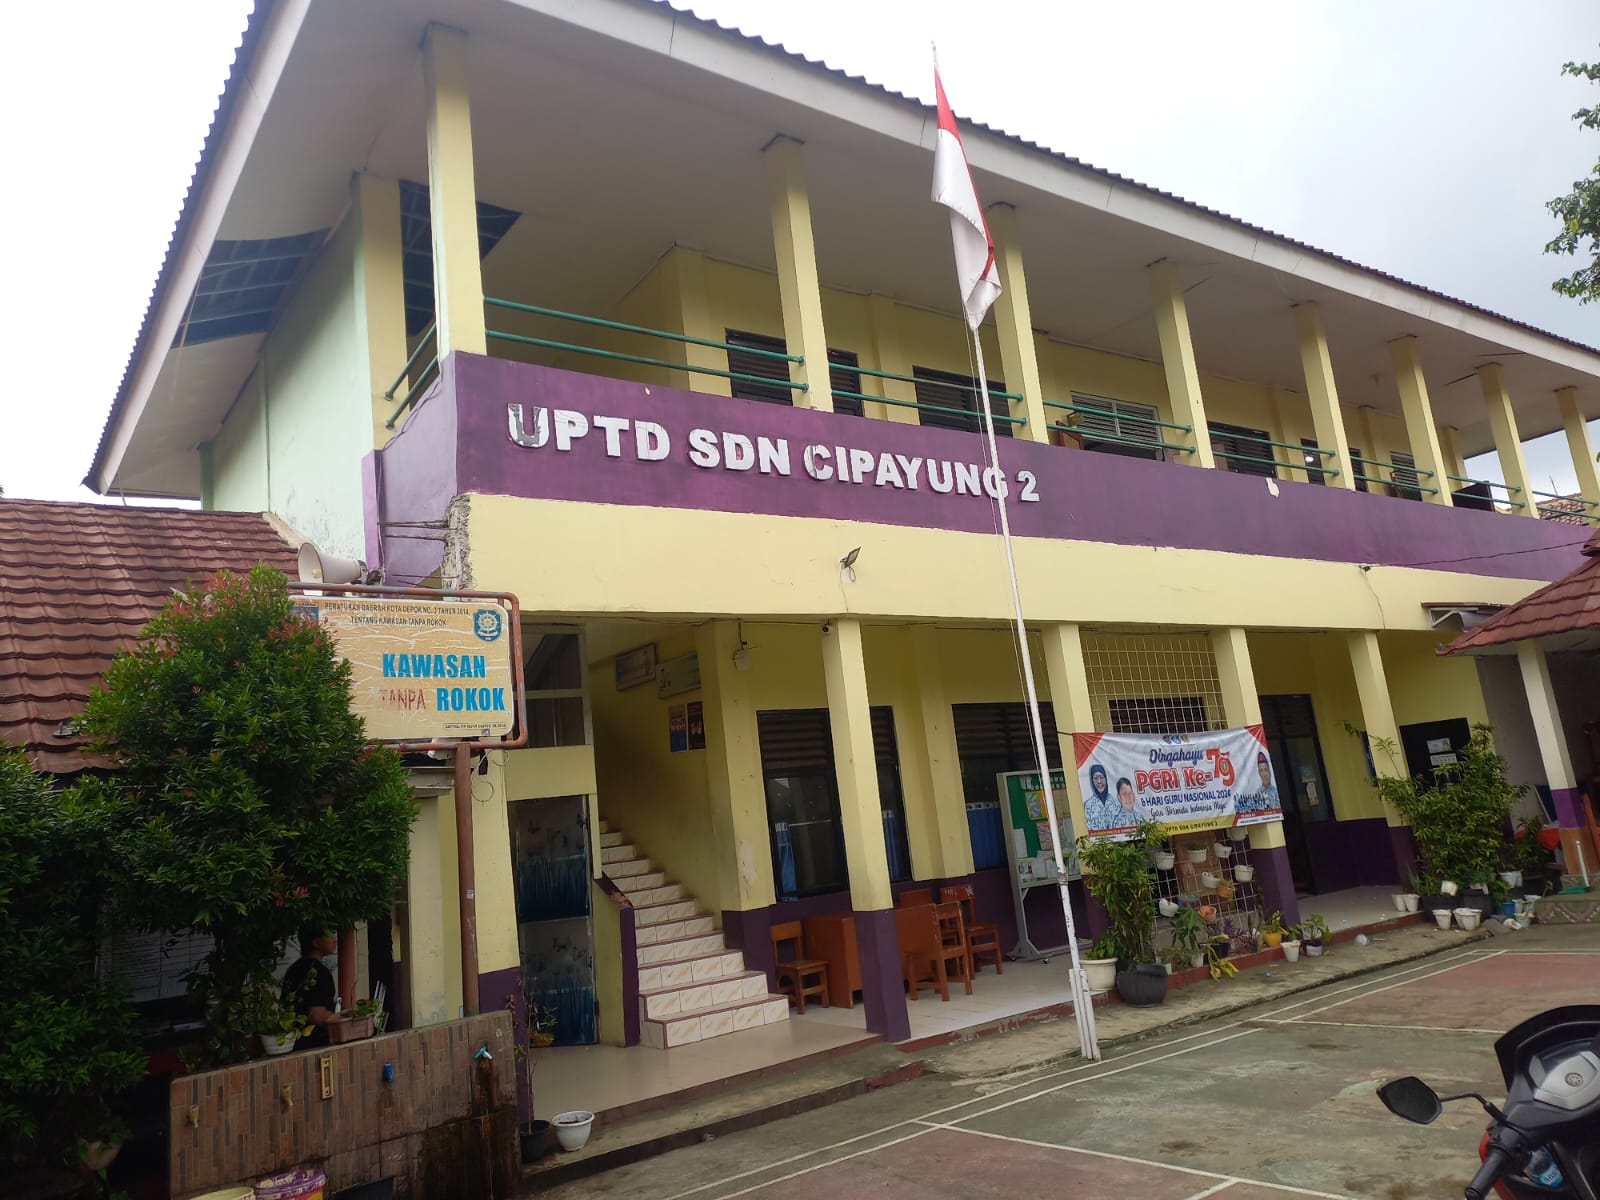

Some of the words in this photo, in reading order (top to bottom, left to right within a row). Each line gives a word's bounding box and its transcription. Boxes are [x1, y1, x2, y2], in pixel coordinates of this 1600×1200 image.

[508, 403, 671, 461] UPTD
[689, 428, 791, 475] SDN
[803, 444, 1009, 500] CIPAYUNG
[1016, 470, 1040, 502] 2
[324, 602, 360, 611] PERATURAN
[362, 604, 385, 612] DAERAH
[386, 605, 402, 613] KOTA
[350, 616, 377, 625] TENTANG
[378, 616, 406, 626] KAWASAN
[407, 618, 426, 626] TANPA
[426, 618, 447, 626] ROKOK
[382, 653, 486, 678] KAWASAN
[379, 688, 426, 711] TANPA
[436, 687, 506, 711] ROKOK
[1149, 748, 1203, 767] Dirgahayu
[1135, 767, 1181, 794] PGRI
[1146, 796, 1163, 806] HARI
[1164, 794, 1183, 805] GURU
[1184, 790, 1216, 803] NASIONAL
[1216, 789, 1231, 799] 2024
